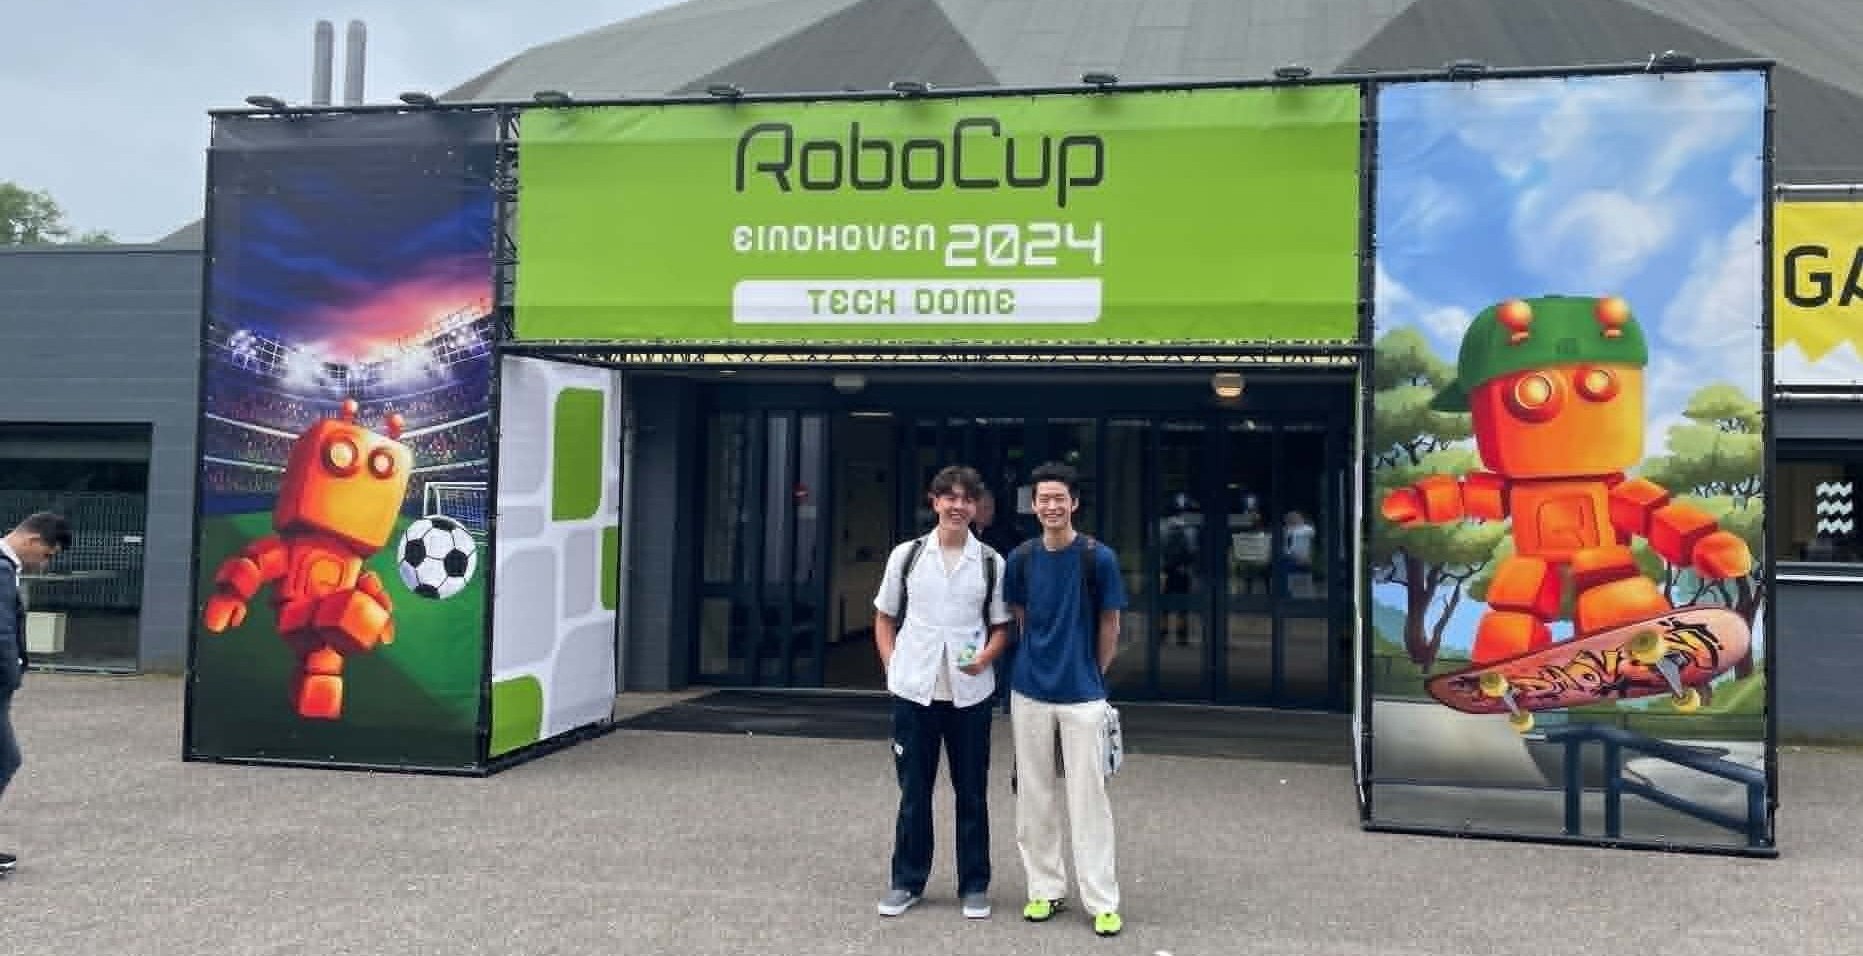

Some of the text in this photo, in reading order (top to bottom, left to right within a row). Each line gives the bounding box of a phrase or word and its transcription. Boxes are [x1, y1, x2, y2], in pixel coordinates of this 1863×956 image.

[735, 117, 1104, 208] RoboCup
[944, 221, 1104, 268] 2024
[807, 288, 1017, 315] TECH DOME
